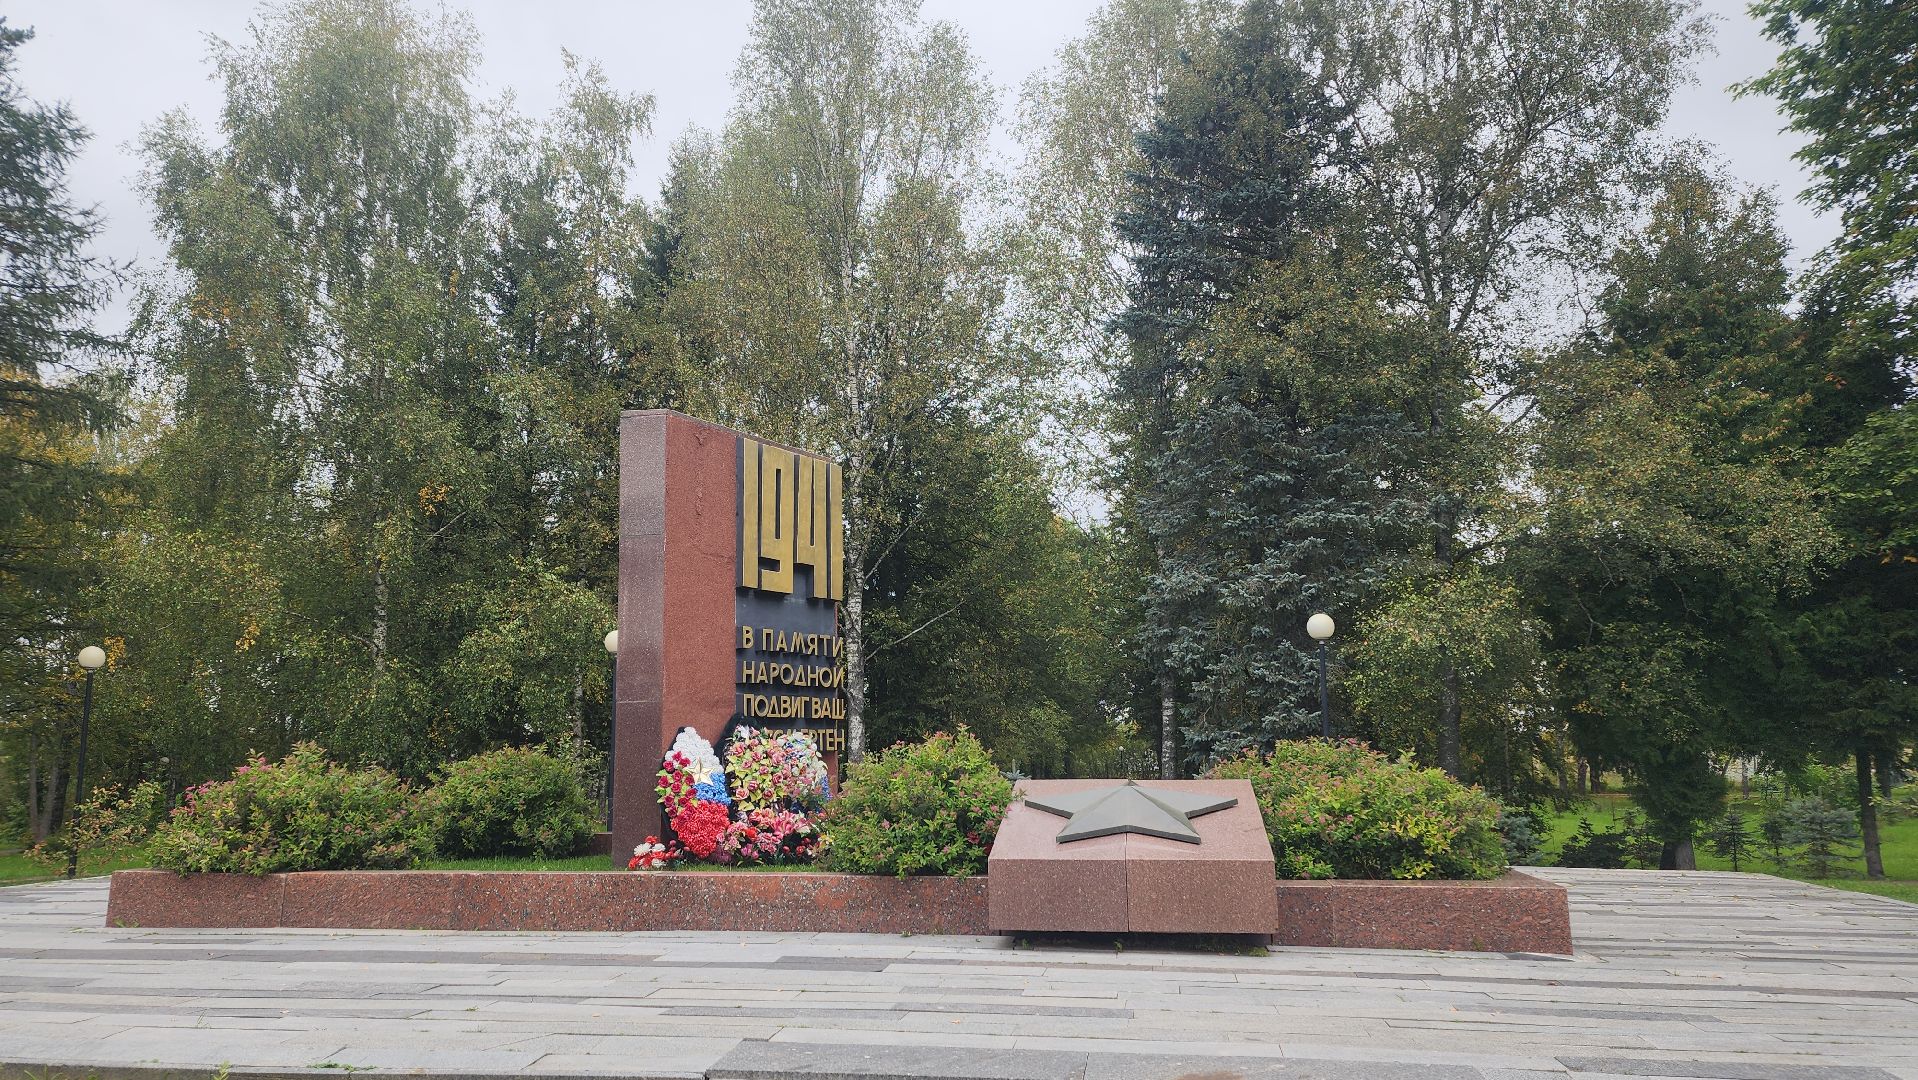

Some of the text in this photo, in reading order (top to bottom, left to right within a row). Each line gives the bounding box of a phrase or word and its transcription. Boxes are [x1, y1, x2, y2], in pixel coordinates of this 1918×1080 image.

[742, 437, 843, 601] 1941
[742, 625, 844, 658] В ПАМЯТИ
[743, 693, 846, 720] ПОДВИГ ВАШ
